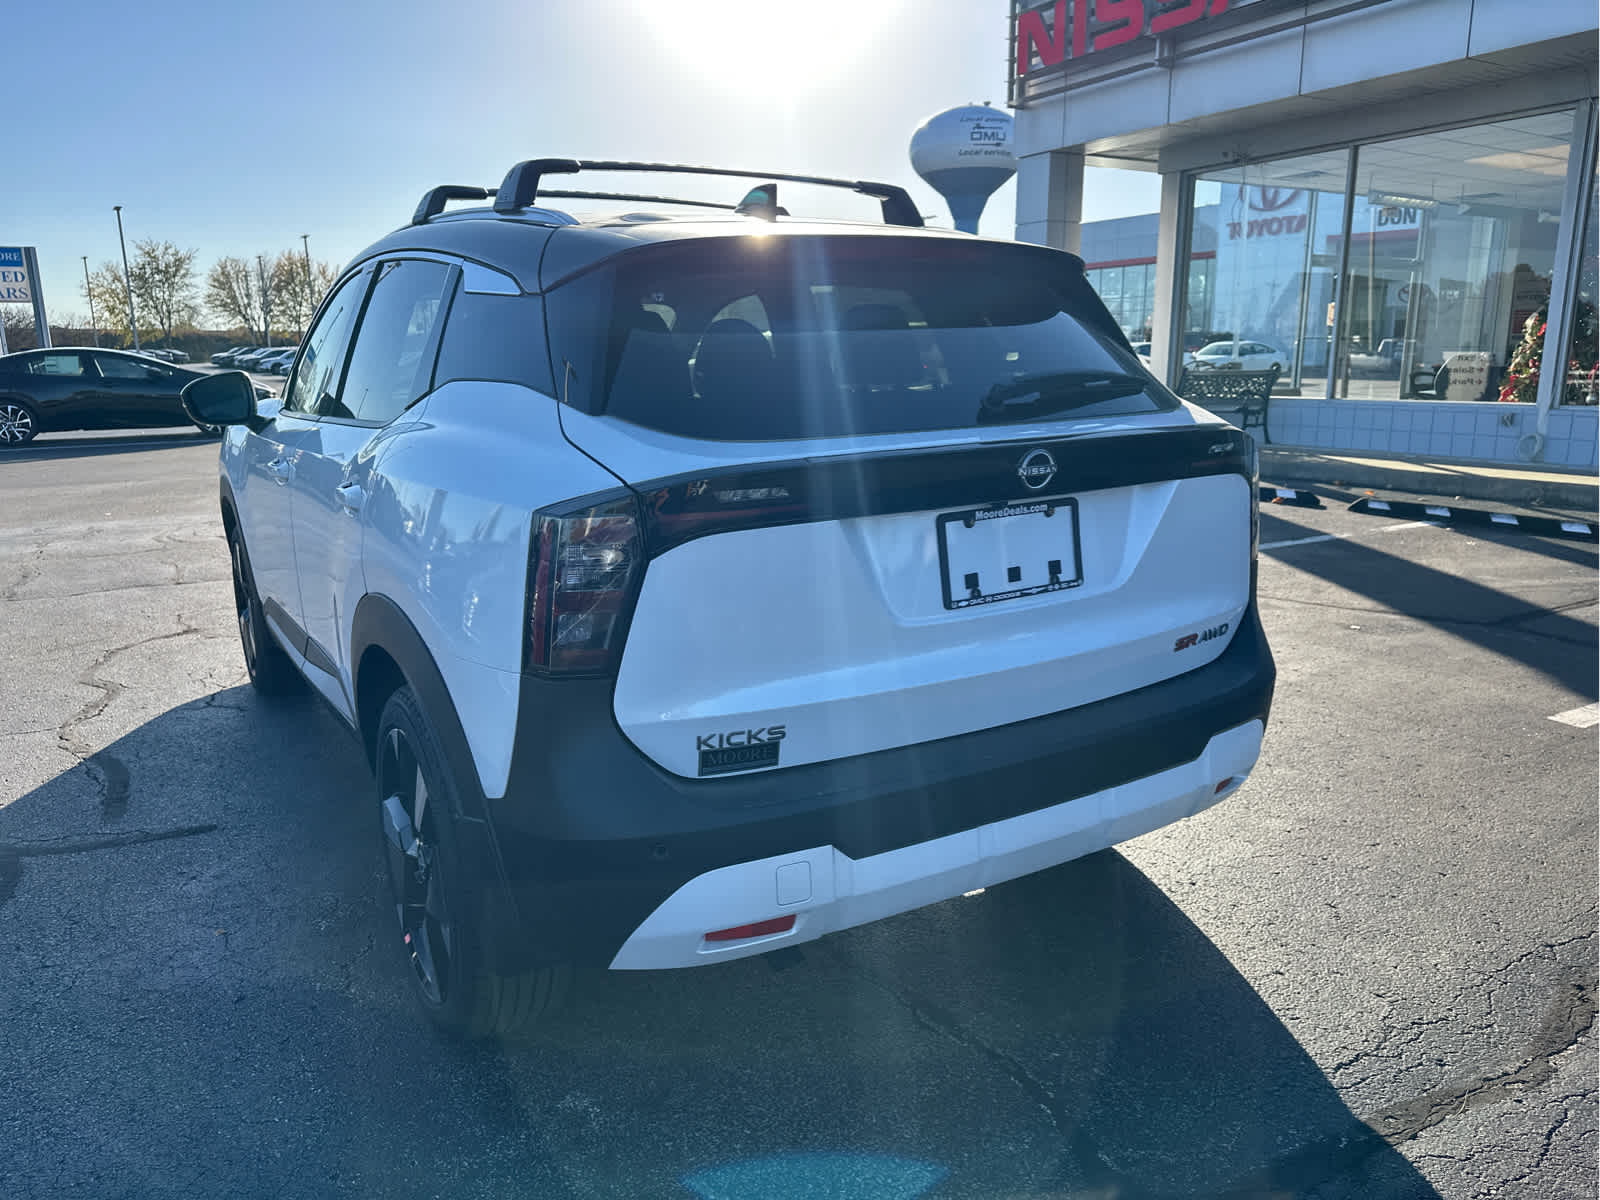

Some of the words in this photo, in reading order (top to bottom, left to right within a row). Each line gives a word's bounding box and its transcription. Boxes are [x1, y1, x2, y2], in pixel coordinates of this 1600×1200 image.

[1018, 465, 1057, 476] NISSAN
[975, 504, 1048, 520] MooreDeals.com
[1174, 633, 1199, 652] SR
[1198, 623, 1229, 643] AWD
[696, 724, 786, 750] KICKS
[709, 745, 772, 764] MOORE
